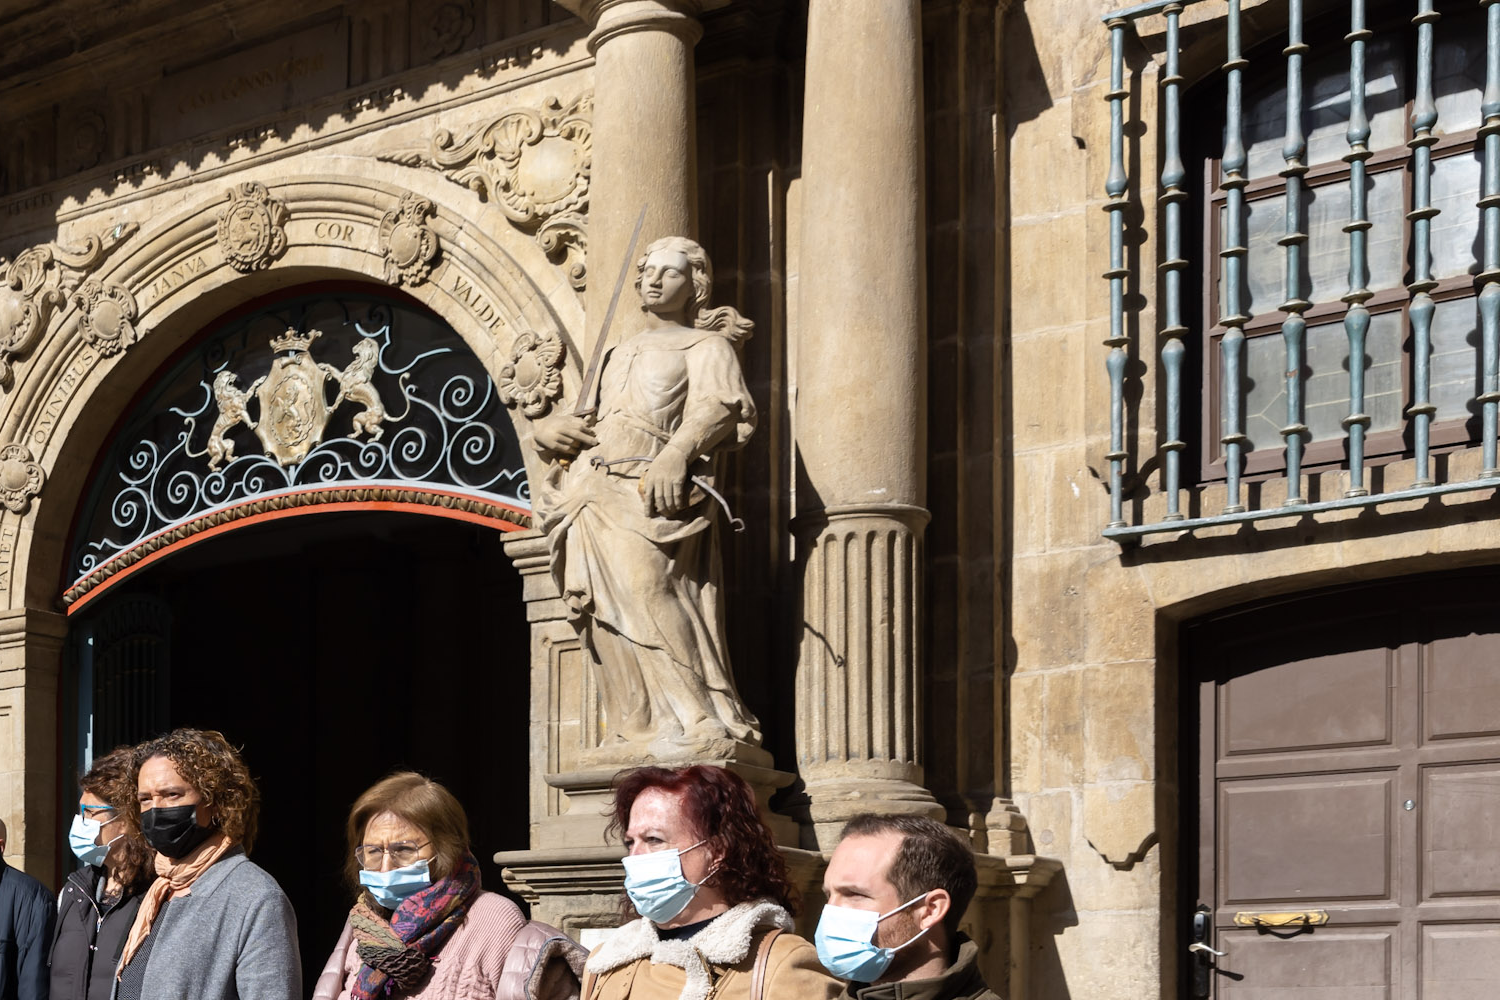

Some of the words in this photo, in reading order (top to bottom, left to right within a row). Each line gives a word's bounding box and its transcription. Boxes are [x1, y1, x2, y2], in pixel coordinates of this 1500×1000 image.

[34, 350, 95, 444] OMNIBUS
[151, 255, 208, 299] JANVA
[314, 221, 354, 242] COR
[453, 275, 505, 335] VALDE
